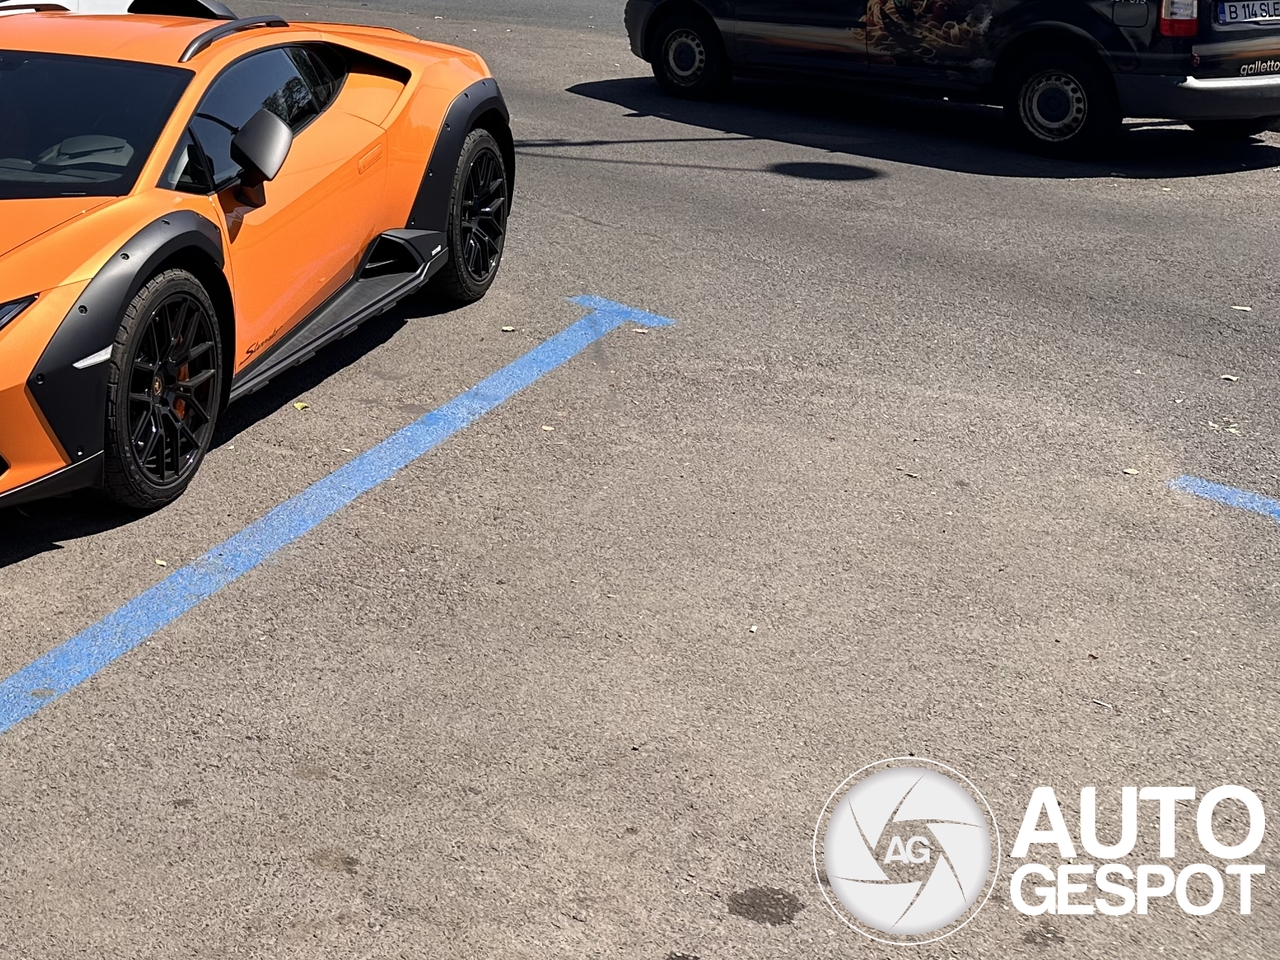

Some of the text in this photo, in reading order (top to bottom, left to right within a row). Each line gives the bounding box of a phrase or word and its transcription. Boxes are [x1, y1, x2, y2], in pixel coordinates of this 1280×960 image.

[1228, 2, 1280, 20] B 114 SLE
